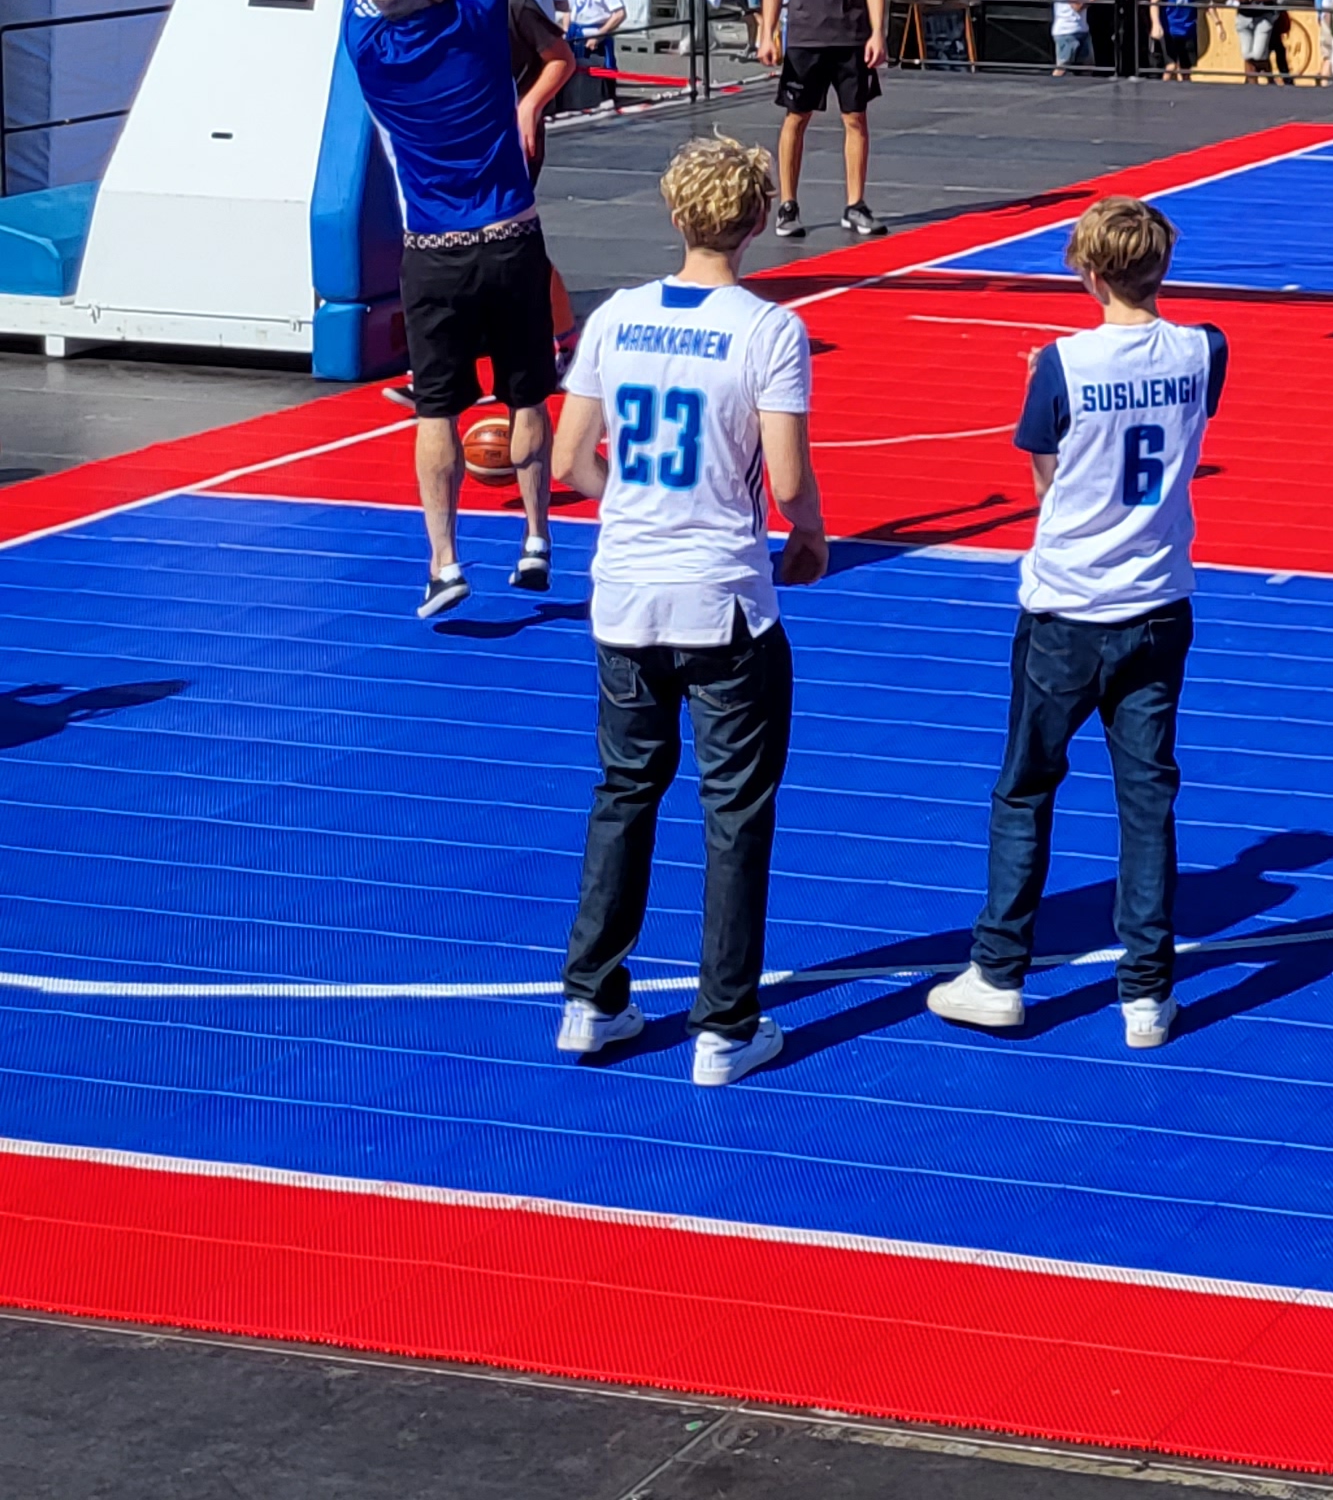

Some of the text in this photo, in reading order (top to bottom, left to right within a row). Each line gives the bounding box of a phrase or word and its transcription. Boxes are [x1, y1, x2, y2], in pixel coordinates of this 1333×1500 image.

[615, 322, 734, 361] MARKKANEN
[1082, 374, 1198, 413] SUSIJENGI
[615, 381, 708, 492] 23
[1121, 422, 1165, 507] 6
